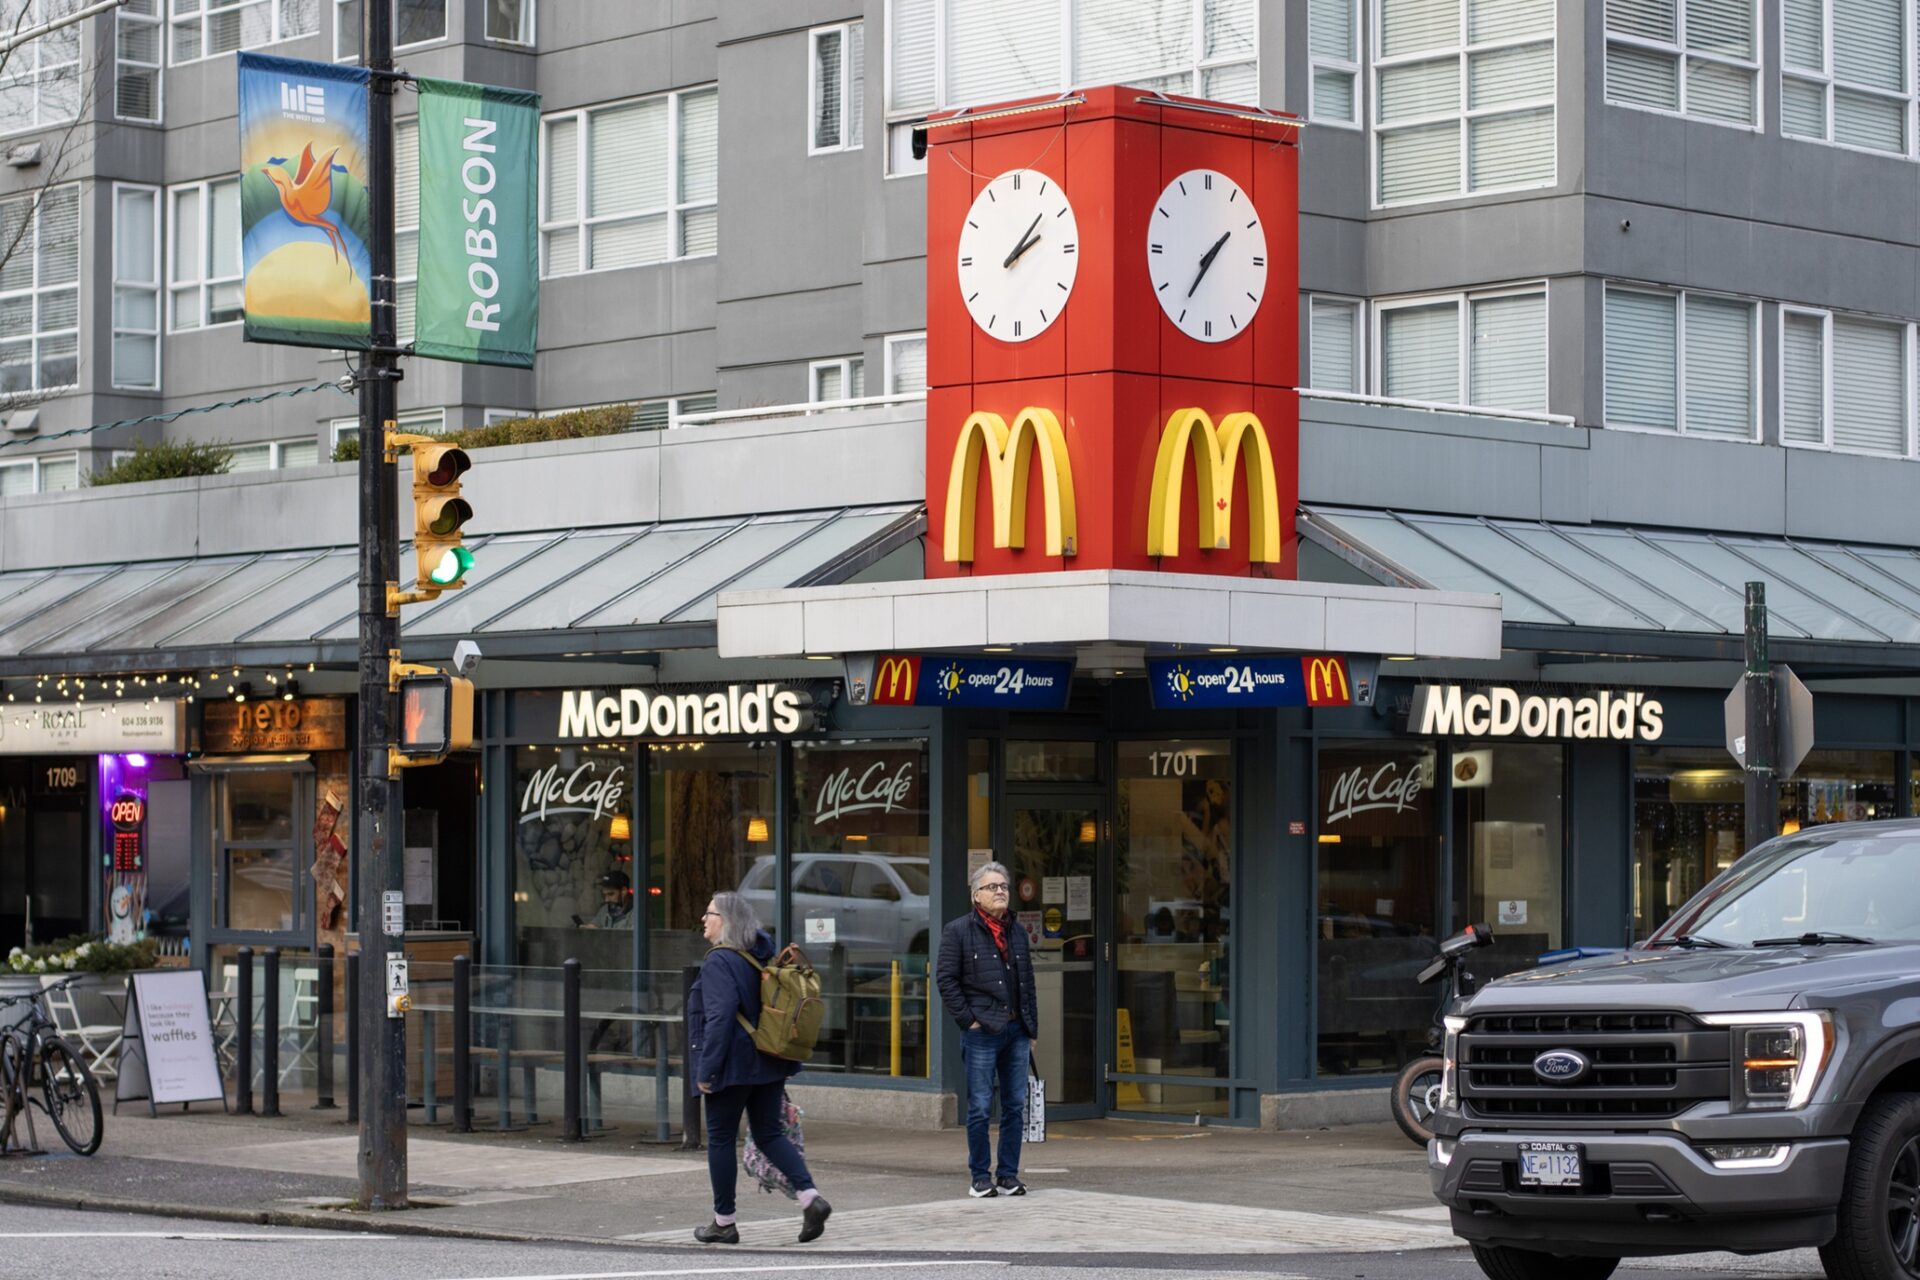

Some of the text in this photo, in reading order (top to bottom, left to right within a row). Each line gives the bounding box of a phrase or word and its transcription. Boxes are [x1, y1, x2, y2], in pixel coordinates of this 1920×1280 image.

[282, 111, 295, 120] THE
[461, 117, 501, 332] ROBSON
[968, 667, 1054, 694] open 24 hours
[1197, 666, 1286, 693] open 24 hours
[42, 711, 86, 729] ROYAL
[558, 683, 800, 738] McDonald's
[1420, 685, 1664, 741] McDonald's
[50, 730, 78, 738] VAPE
[1149, 751, 1198, 776] 1701
[47, 767, 77, 788] 1709
[520, 761, 624, 823] McCafé
[815, 760, 913, 822] McCafé
[1327, 761, 1422, 821] McCafé
[112, 802, 144, 822] OPEN
[175, 1011, 190, 1019] they
[151, 1028, 198, 1042] waffles
[1544, 1058, 1571, 1073] Ford
[1531, 1143, 1566, 1151] COASTAL
[1548, 1155, 1580, 1175] 1132
